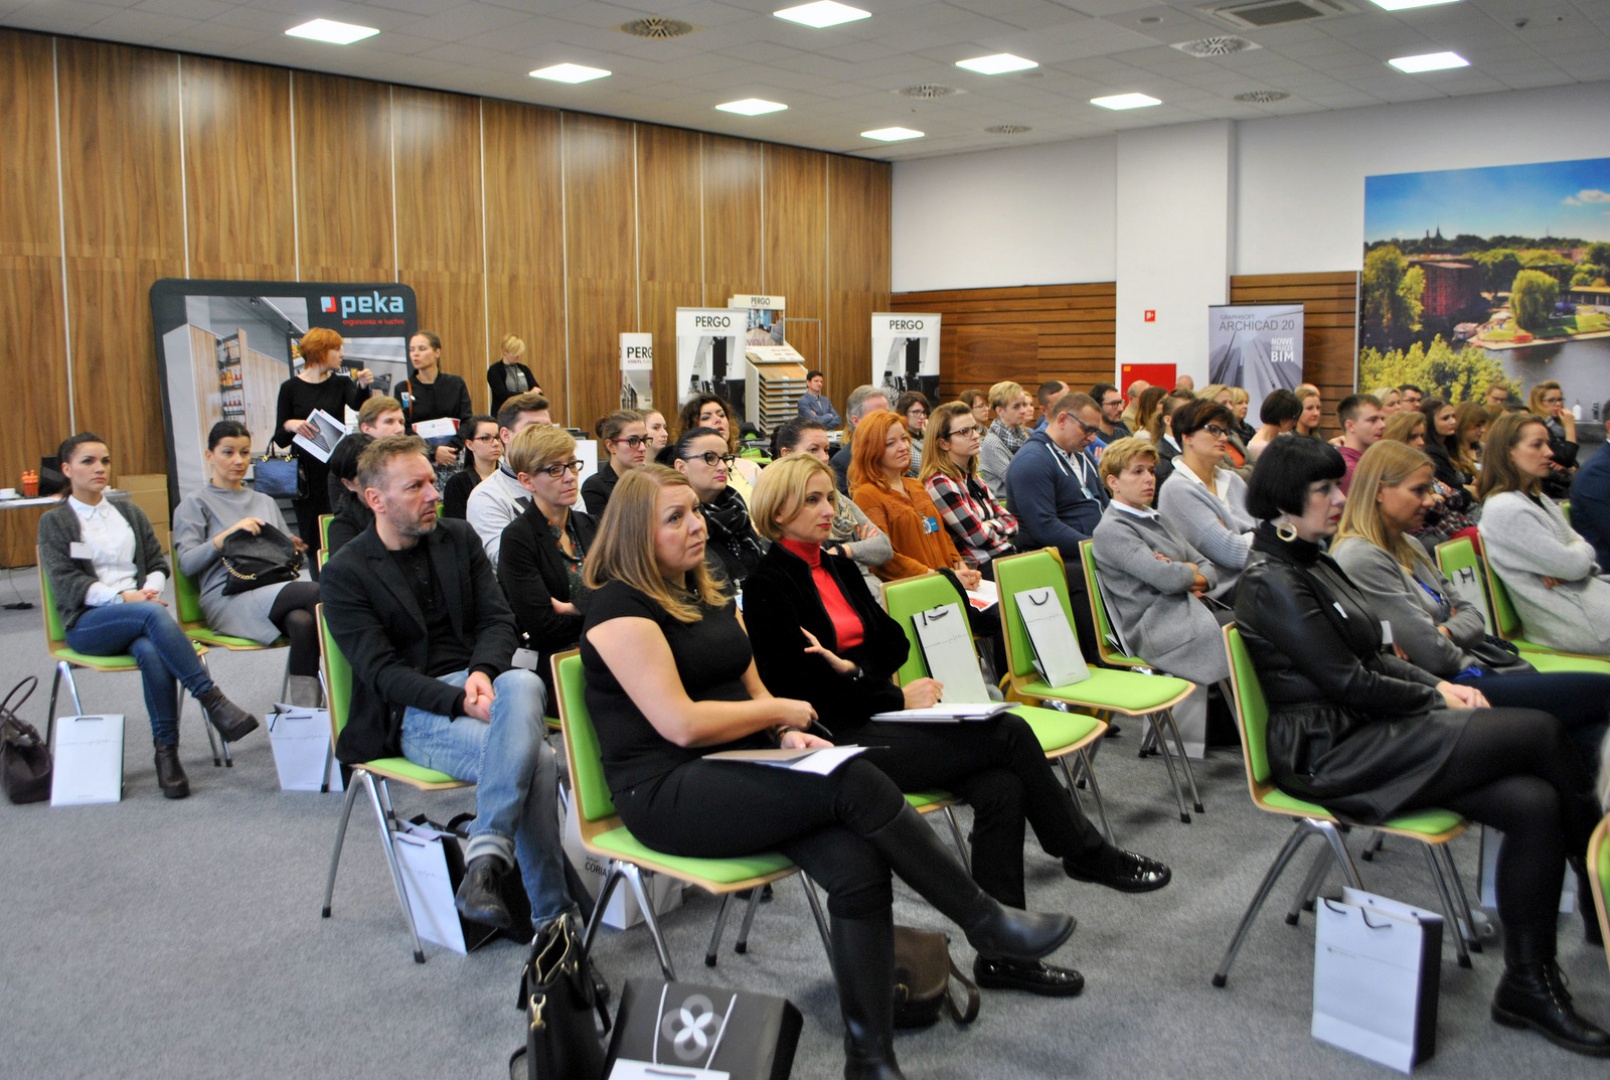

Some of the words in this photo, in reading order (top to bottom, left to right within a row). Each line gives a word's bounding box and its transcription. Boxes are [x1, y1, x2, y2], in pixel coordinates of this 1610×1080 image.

[341, 290, 404, 319] peka
[750, 297, 771, 305] PERGO
[695, 315, 731, 328] PERGO
[889, 319, 924, 330] PERGO
[1219, 320, 1279, 331] ARCHICAD
[1281, 320, 1295, 330] 20
[1271, 337, 1294, 345] NOWE
[1271, 351, 1294, 362] BIM
[585, 861, 608, 877] CORIA
